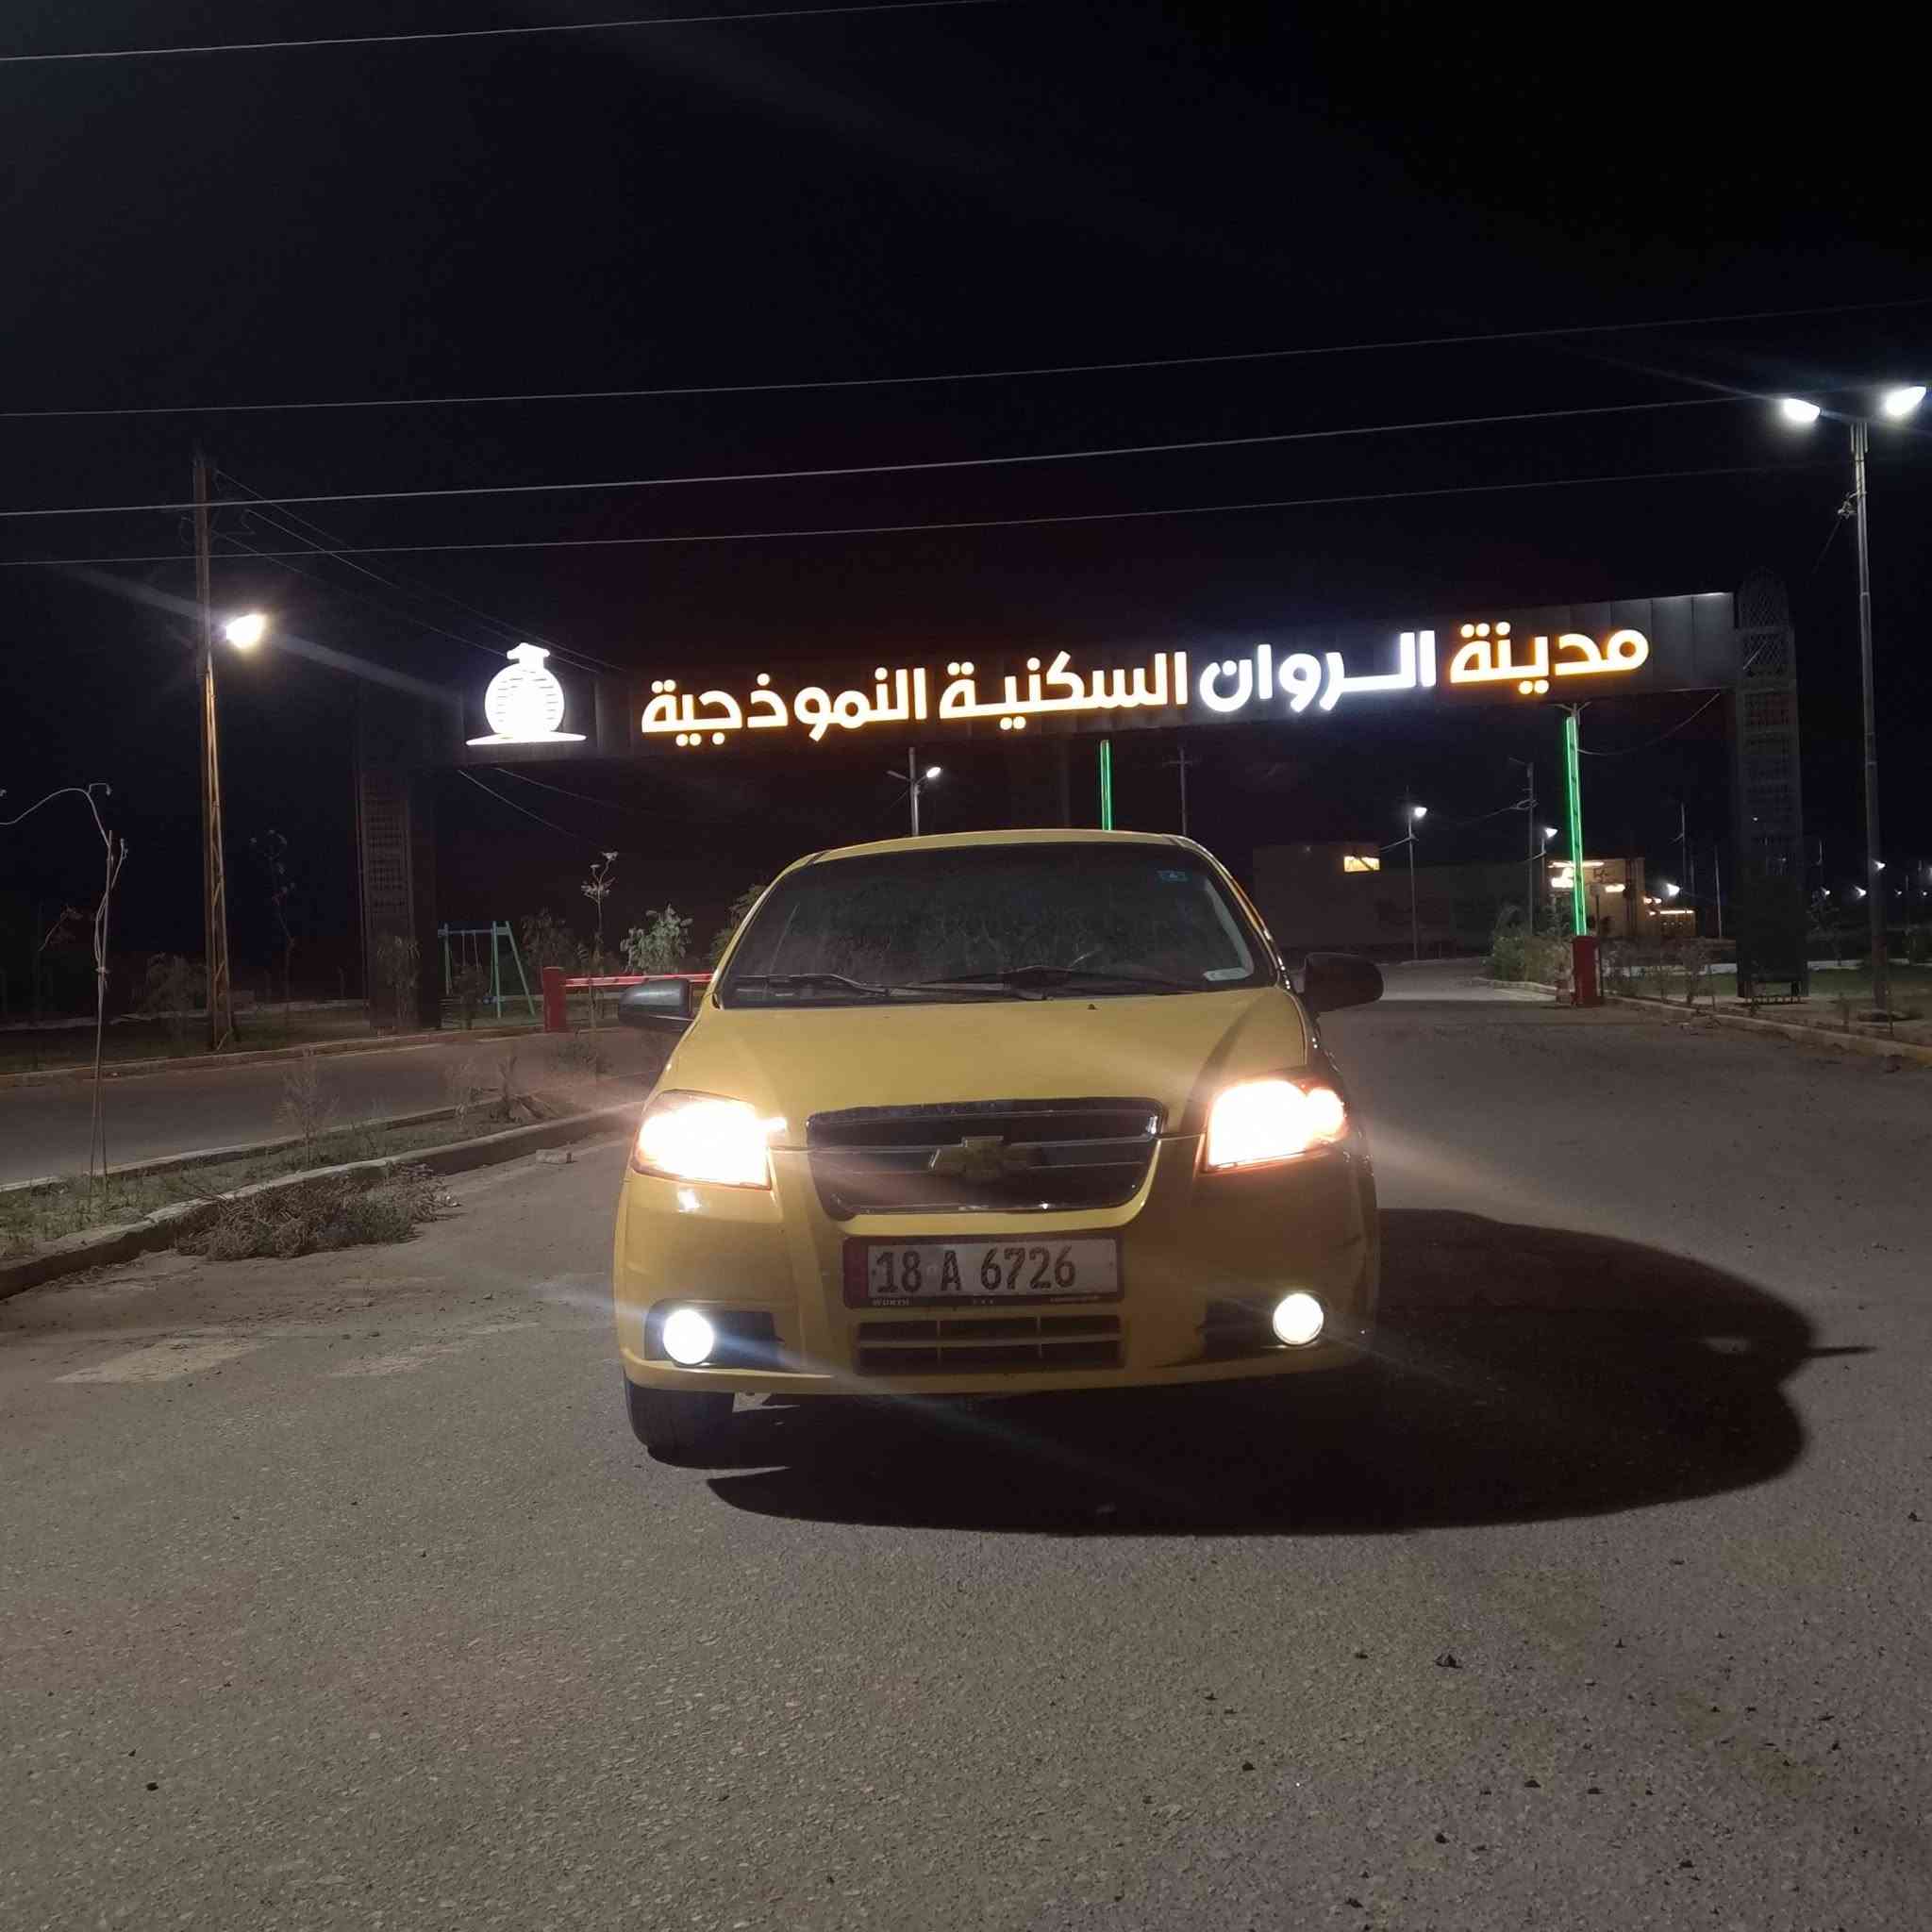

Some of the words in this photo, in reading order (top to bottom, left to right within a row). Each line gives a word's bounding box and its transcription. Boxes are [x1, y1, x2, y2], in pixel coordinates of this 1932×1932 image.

[939, 650, 1188, 731] السكنية
[1449, 621, 1650, 695] مدينة
[641, 666, 927, 746] النموذجية
[875, 1250, 923, 1293] 18
[941, 1249, 962, 1291] A
[980, 1244, 1076, 1291] 6726
